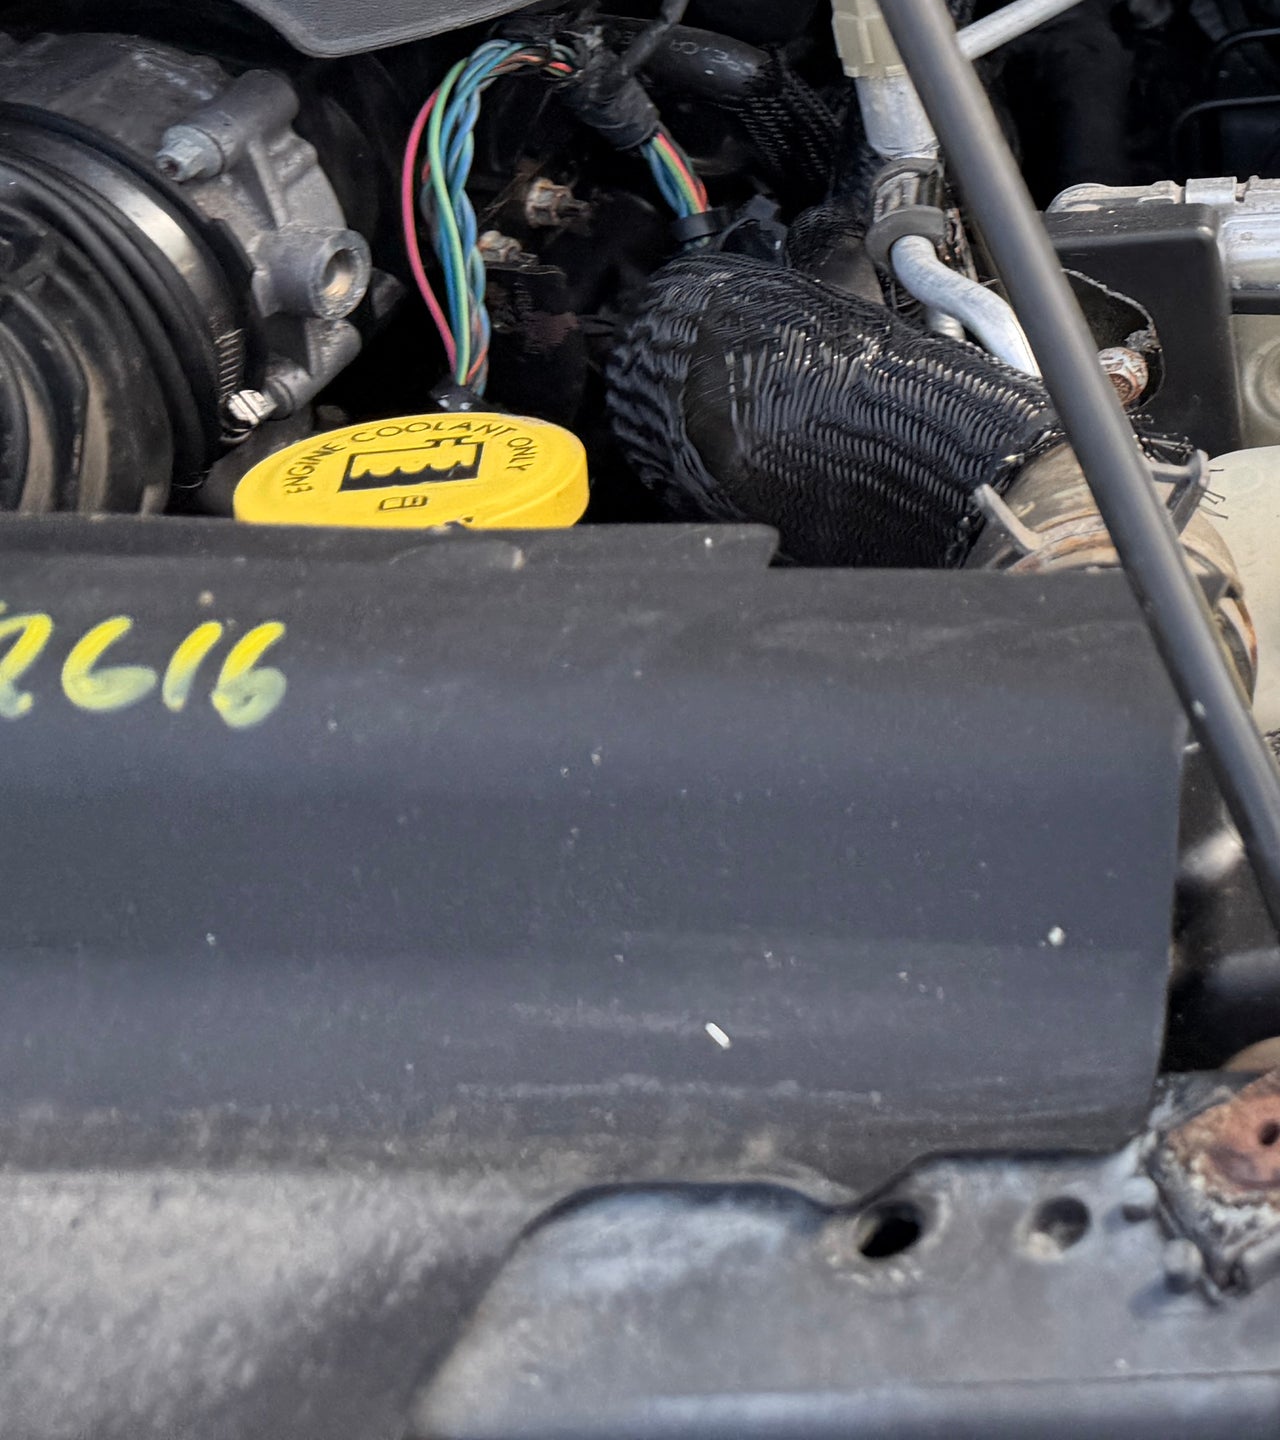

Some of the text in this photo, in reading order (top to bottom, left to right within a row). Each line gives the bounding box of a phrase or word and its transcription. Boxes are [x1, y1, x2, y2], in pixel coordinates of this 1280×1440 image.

[282, 420, 539, 496] ENGINE COOLANT ONLY
